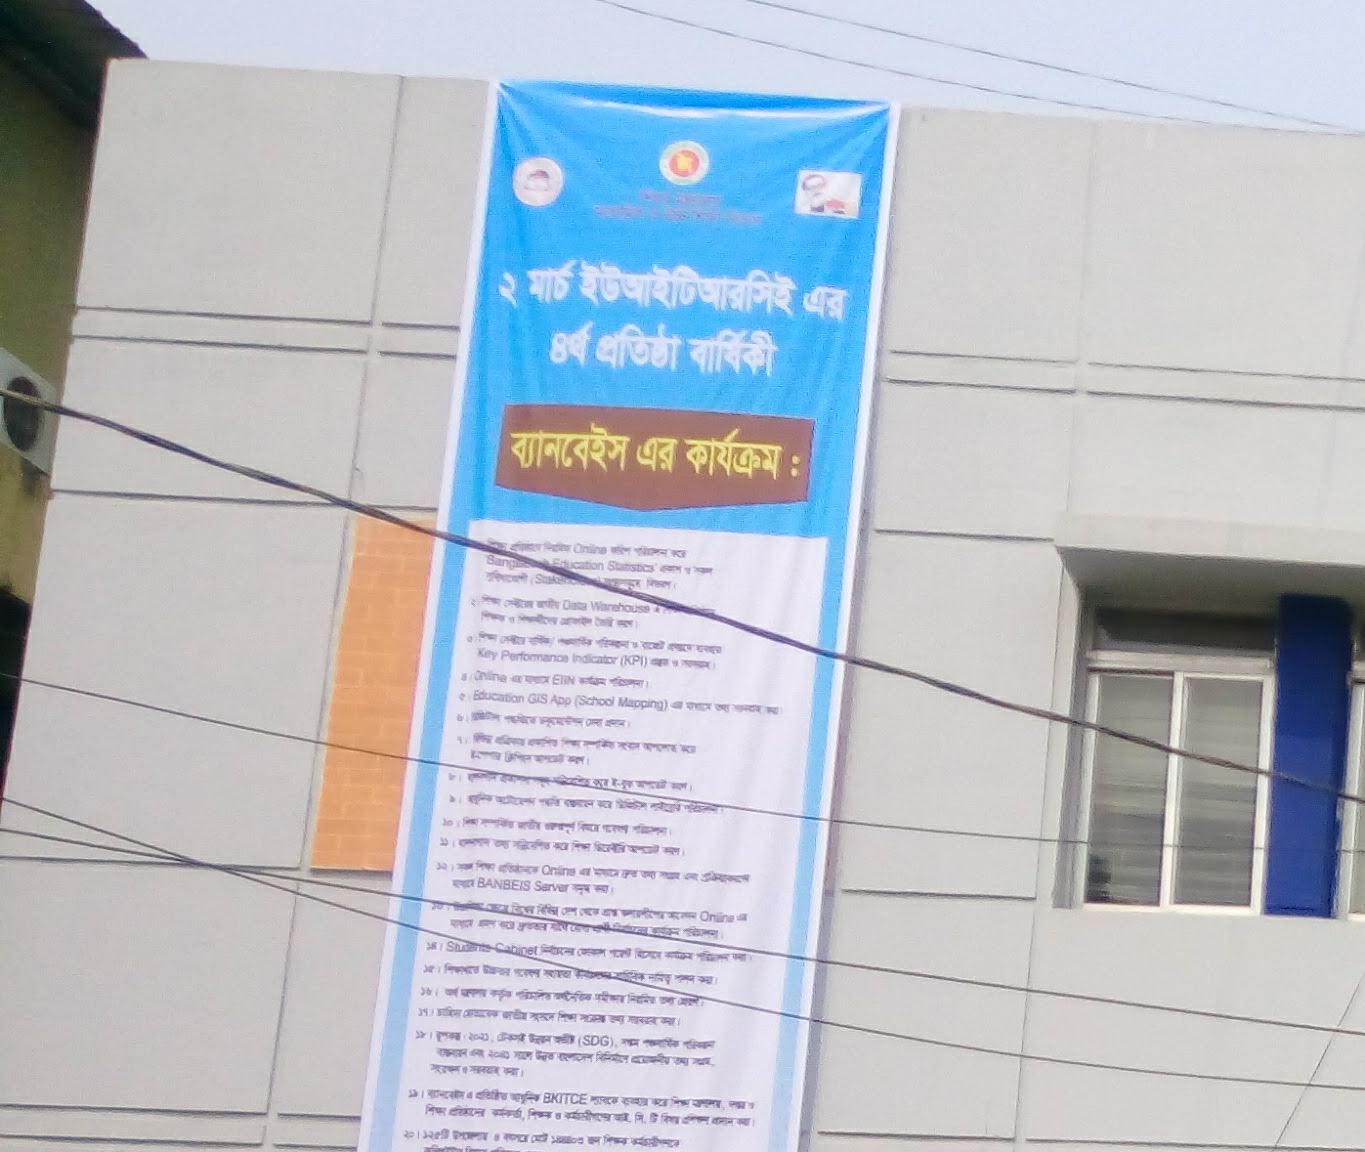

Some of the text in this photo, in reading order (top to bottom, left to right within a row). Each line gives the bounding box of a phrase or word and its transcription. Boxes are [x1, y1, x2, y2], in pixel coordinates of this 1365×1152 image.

[499, 274, 517, 305] ২
[528, 259, 575, 303] মার্চ
[803, 285, 847, 320] এর
[596, 323, 680, 369] প্রতিষ্ঠা
[510, 423, 629, 470] ব্যানবেইস
[637, 438, 673, 472] এর
[686, 429, 781, 479] কার্যক্রম
[591, 601, 650, 613] Warehouse
[478, 648, 647, 668] Key Performance Indicator (KPI)
[473, 690, 524, 703] Education
[528, 693, 548, 704] GIS
[551, 695, 571, 706] App
[575, 695, 614, 708] (School
[618, 697, 668, 711] Mapping)
[542, 865, 575, 876] Online
[478, 878, 530, 891] BANBEIS
[534, 881, 569, 892] Server
[700, 911, 734, 923] Online
[543, 1093, 587, 1104] BKITCE
